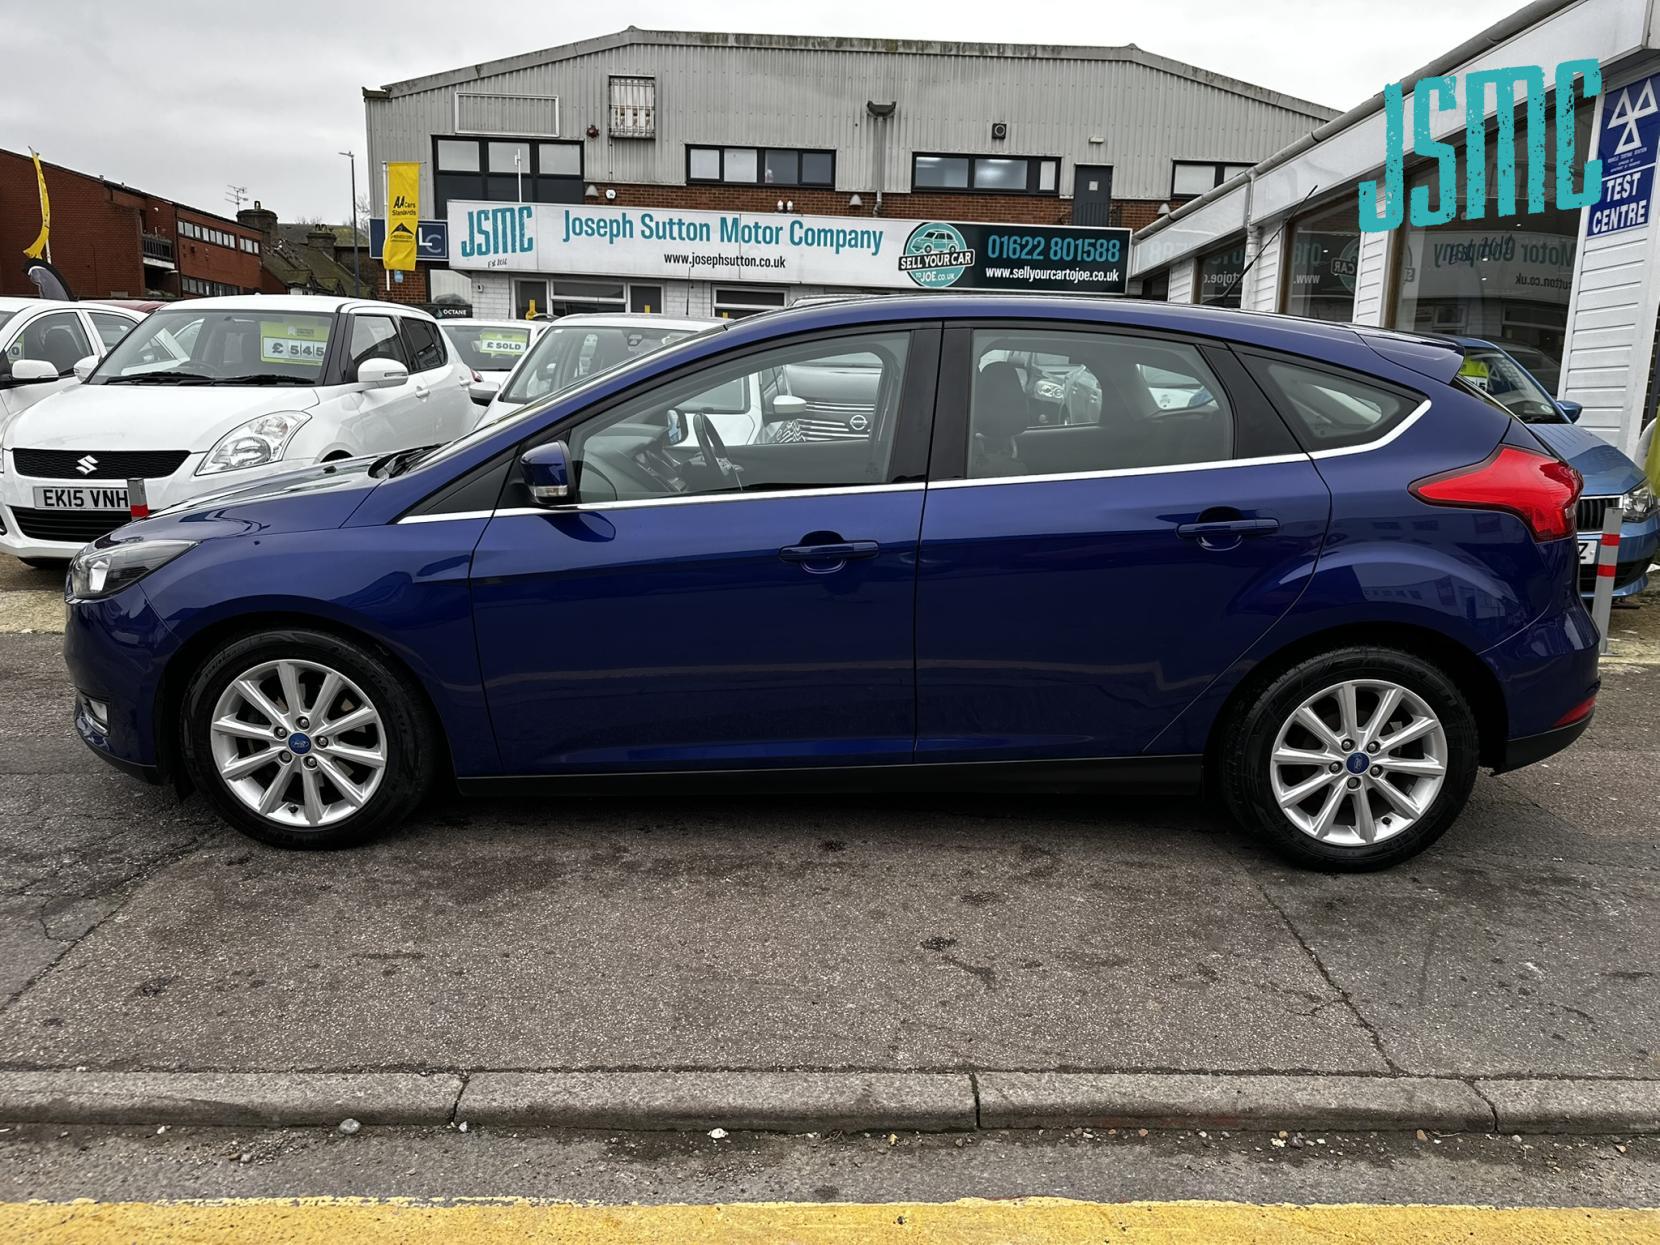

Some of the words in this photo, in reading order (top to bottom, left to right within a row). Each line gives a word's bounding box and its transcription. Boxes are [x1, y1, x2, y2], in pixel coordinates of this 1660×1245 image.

[1607, 171, 1642, 202] TEST
[1592, 199, 1648, 234] CENTRE
[461, 206, 534, 258] JSMC
[563, 209, 634, 244] Joseph
[640, 213, 711, 242] Sutton
[719, 216, 784, 246] Motor
[789, 219, 884, 257] Company
[987, 234, 1046, 260] 01622
[1049, 236, 1120, 262] 801588
[664, 251, 786, 269] www.josephsutton.co.uk
[900, 257, 923, 270] SELL
[923, 254, 950, 268] YOUR
[951, 252, 972, 265] CAR
[985, 265, 1120, 284] www.sellyourcartojoe.co.uk
[443, 308, 467, 316] OCTANE
[271, 342, 284, 354] £
[495, 341, 521, 351] SOLD
[43, 489, 85, 508] EK15
[89, 489, 129, 508] VNH
